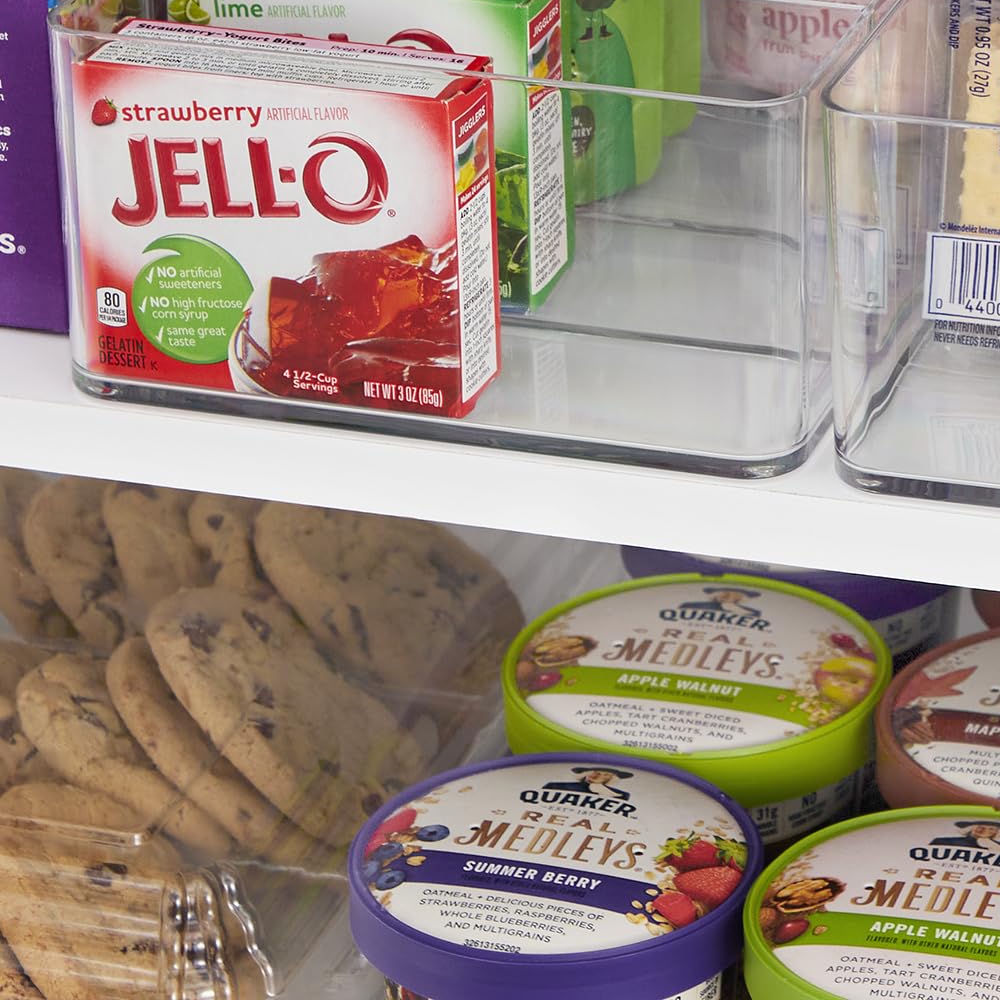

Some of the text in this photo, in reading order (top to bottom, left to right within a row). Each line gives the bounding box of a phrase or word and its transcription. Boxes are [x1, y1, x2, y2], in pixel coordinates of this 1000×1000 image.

[976, 5, 992, 23] WT
[975, 26, 991, 48] 0.95
[975, 52, 990, 67] OZ
[971, 69, 991, 99] (27g)
[122, 100, 349, 127] strawberry ARTIFICIAL FLAVOR
[157, 266, 222, 279] NO artificial
[159, 279, 222, 290] sweeteners
[150, 296, 243, 311] NO high fructose
[152, 310, 208, 323] corn syrup
[166, 327, 227, 338] same great
[168, 336, 196, 347] taste
[364, 381, 443, 407] NET WT 3 OZ (85g)
[659, 607, 772, 632] QUAKER
[662, 628, 755, 648] REAL
[602, 636, 782, 680] MEDLEYS
[617, 673, 674, 689] APPLE
[676, 679, 743, 698] WALNUT
[519, 789, 638, 818] QUAKER
[520, 811, 617, 835] REAL
[453, 820, 648, 872] MEDLEYS
[463, 860, 535, 881] SUMMER
[545, 872, 602, 891] BERRY
[870, 921, 930, 938] APPLE
